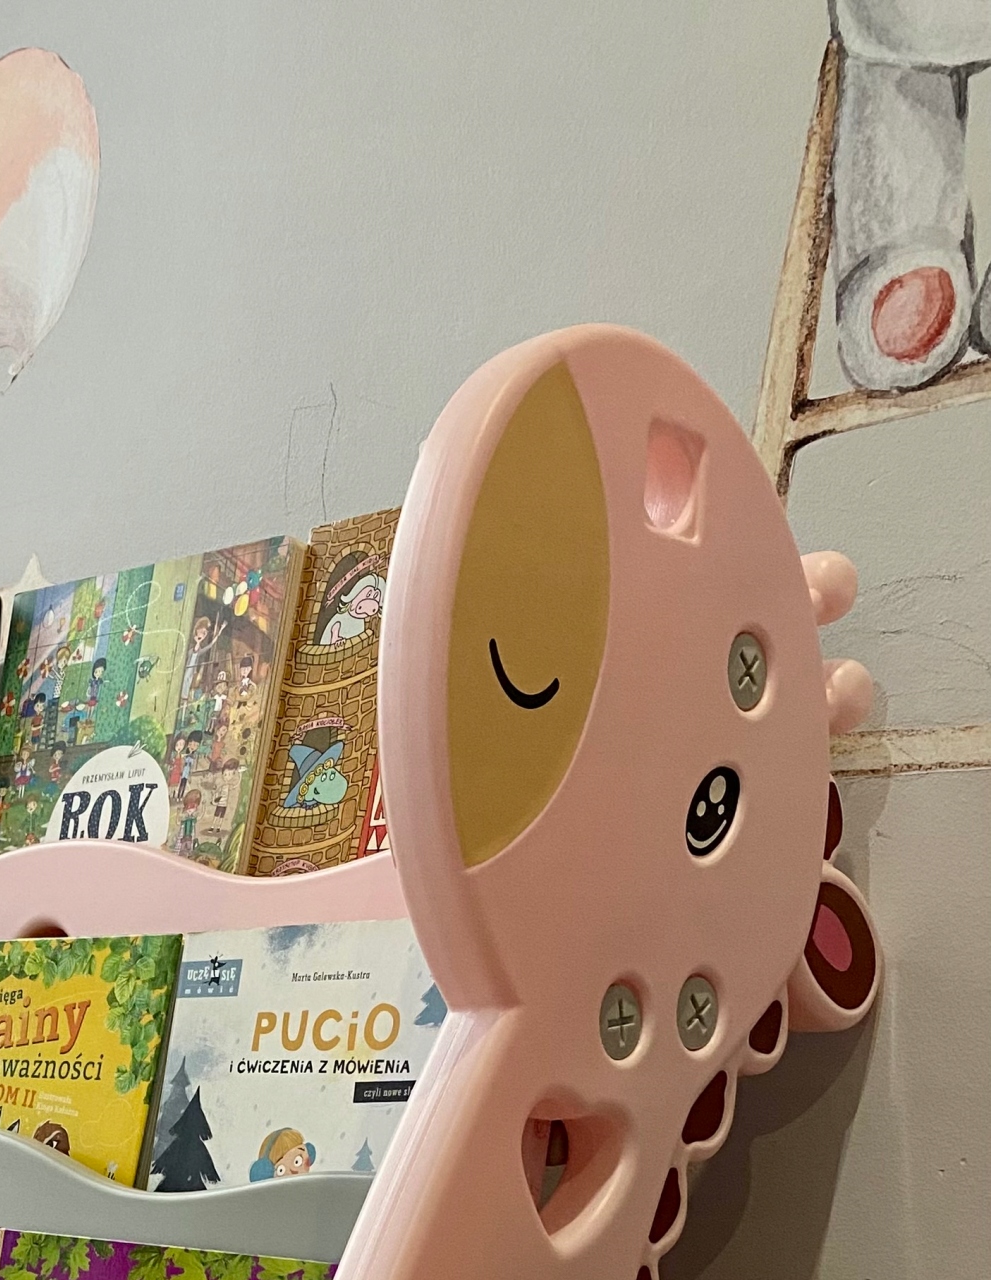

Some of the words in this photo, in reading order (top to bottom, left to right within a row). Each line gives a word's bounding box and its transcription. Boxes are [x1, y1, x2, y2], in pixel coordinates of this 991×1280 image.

[81, 771, 125, 784] PRZEMYSŁAW
[59, 783, 158, 842] ROK
[187, 966, 210, 981] UCZĘ
[221, 967, 237, 981] SIĘ
[291, 972, 311, 983] Marta
[313, 971, 370, 982] Galewska-Kustra
[229, 1060, 234, 1073] i
[318, 1060, 328, 1073] Z
[22, 1089, 38, 1109] II
[363, 1087, 381, 1099] czyli
[383, 1089, 402, 1097] nowe
